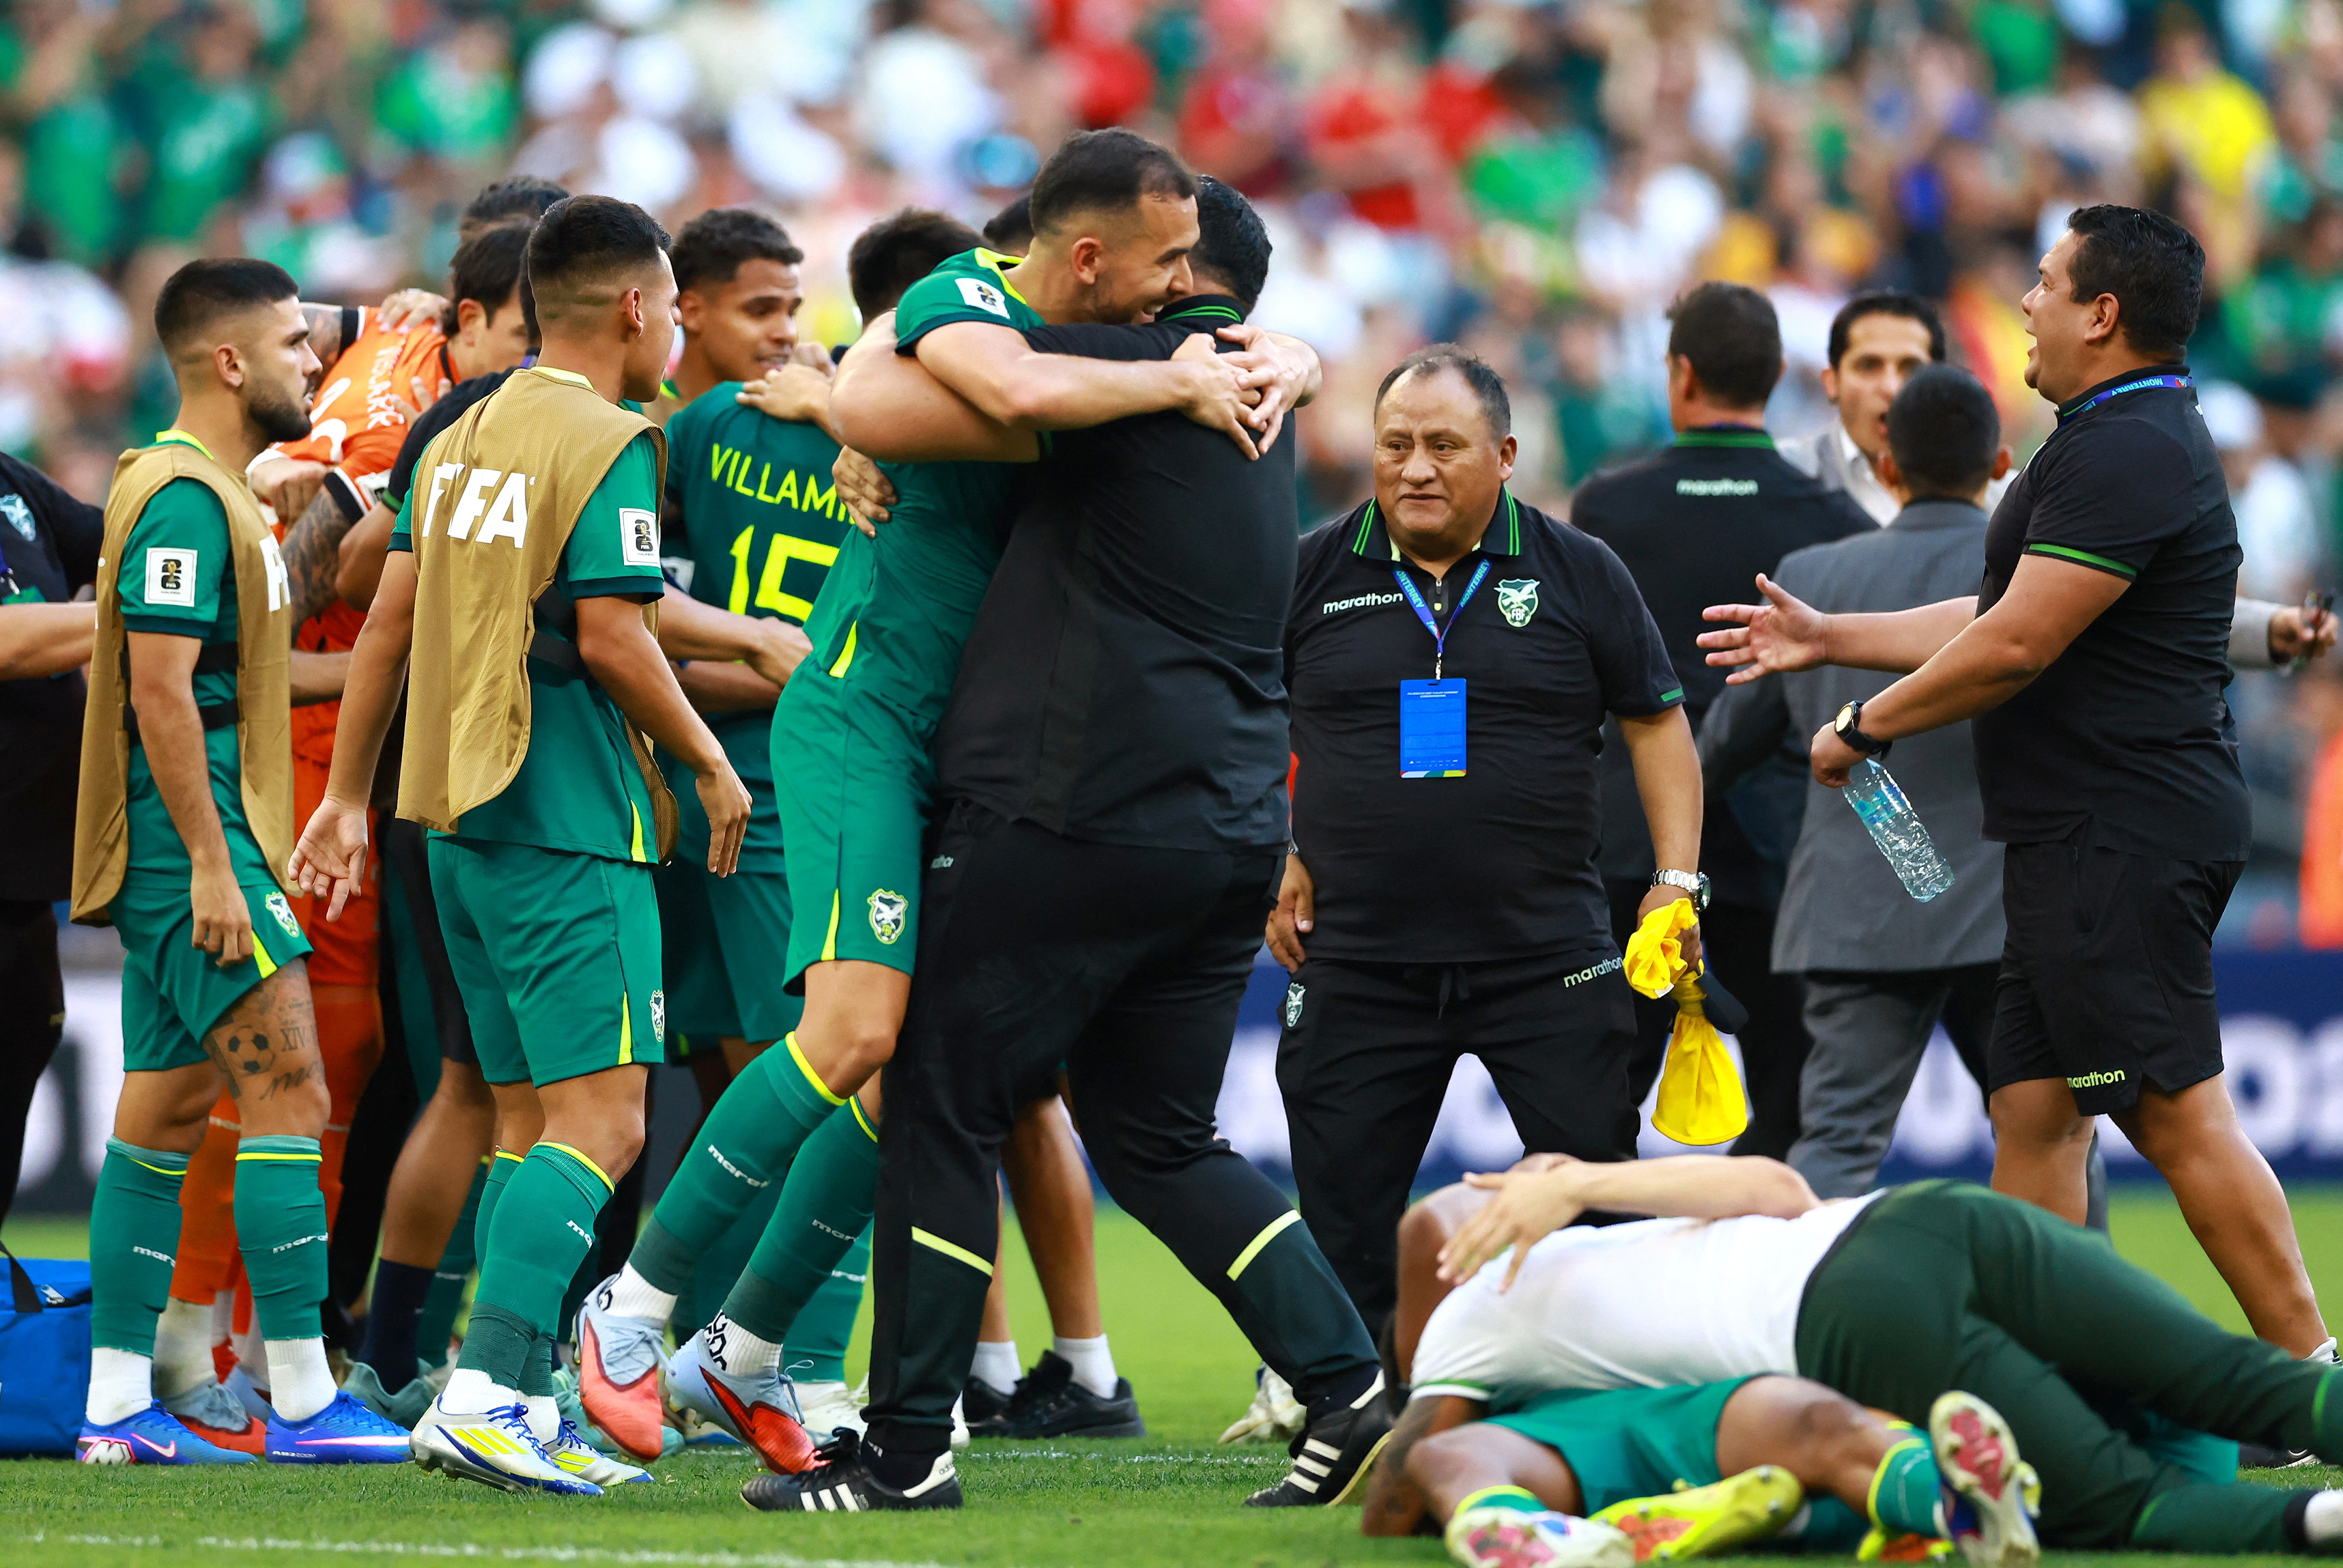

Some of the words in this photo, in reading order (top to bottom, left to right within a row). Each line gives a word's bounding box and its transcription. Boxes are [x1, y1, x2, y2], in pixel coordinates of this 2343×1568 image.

[2112, 377, 2163, 396] MONTERREY
[1676, 477, 1759, 496] marathon
[1323, 593, 1403, 614] marathon
[1511, 608, 1526, 621] FBF
[1563, 956, 1623, 988] marathon
